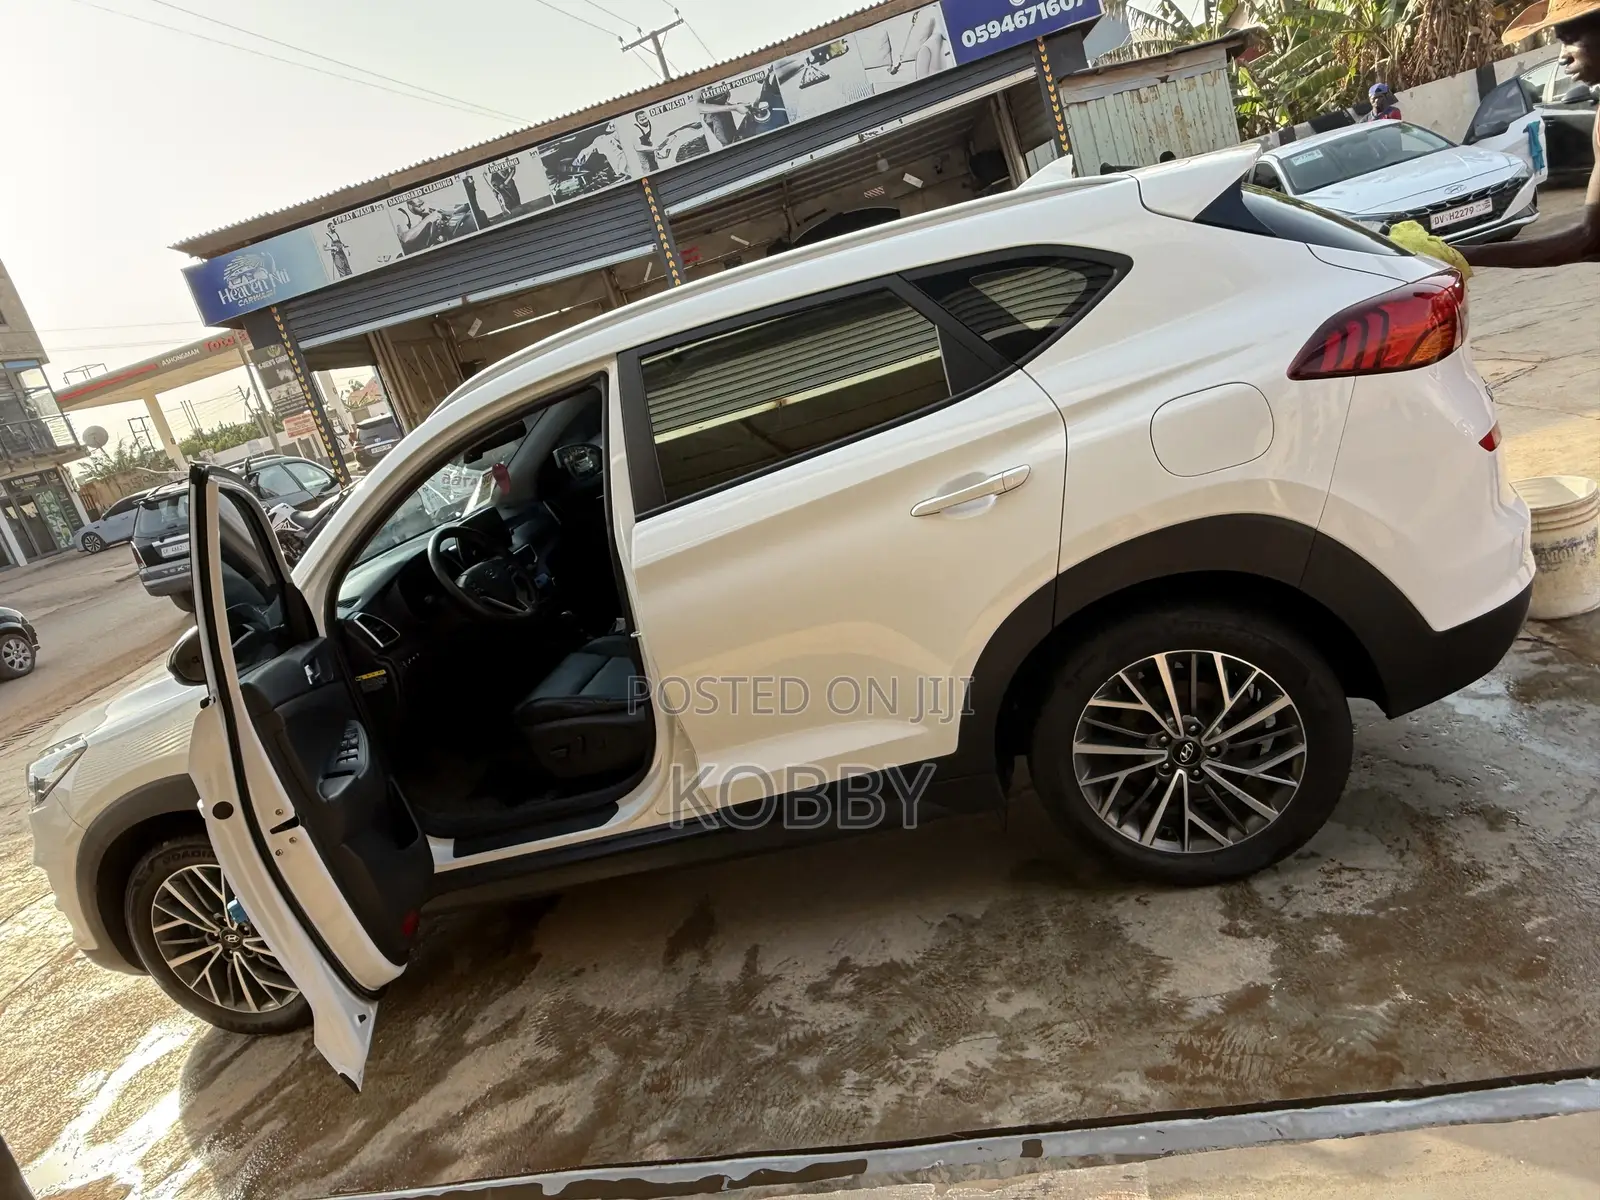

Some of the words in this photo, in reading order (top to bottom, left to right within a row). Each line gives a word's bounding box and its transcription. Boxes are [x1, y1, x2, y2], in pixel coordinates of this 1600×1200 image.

[702, 83, 731, 99] EXTERIOR
[733, 71, 765, 88] POLISHING
[650, 105, 664, 117] DRY
[667, 98, 685, 111] WASH
[388, 190, 422, 206] DASHBOARD
[423, 179, 452, 194] CLEANING
[335, 212, 353, 225] SPRAY
[355, 205, 373, 219] WASH
[1434, 214, 1444, 225] DV
[161, 347, 200, 367] ASHONGMAN
